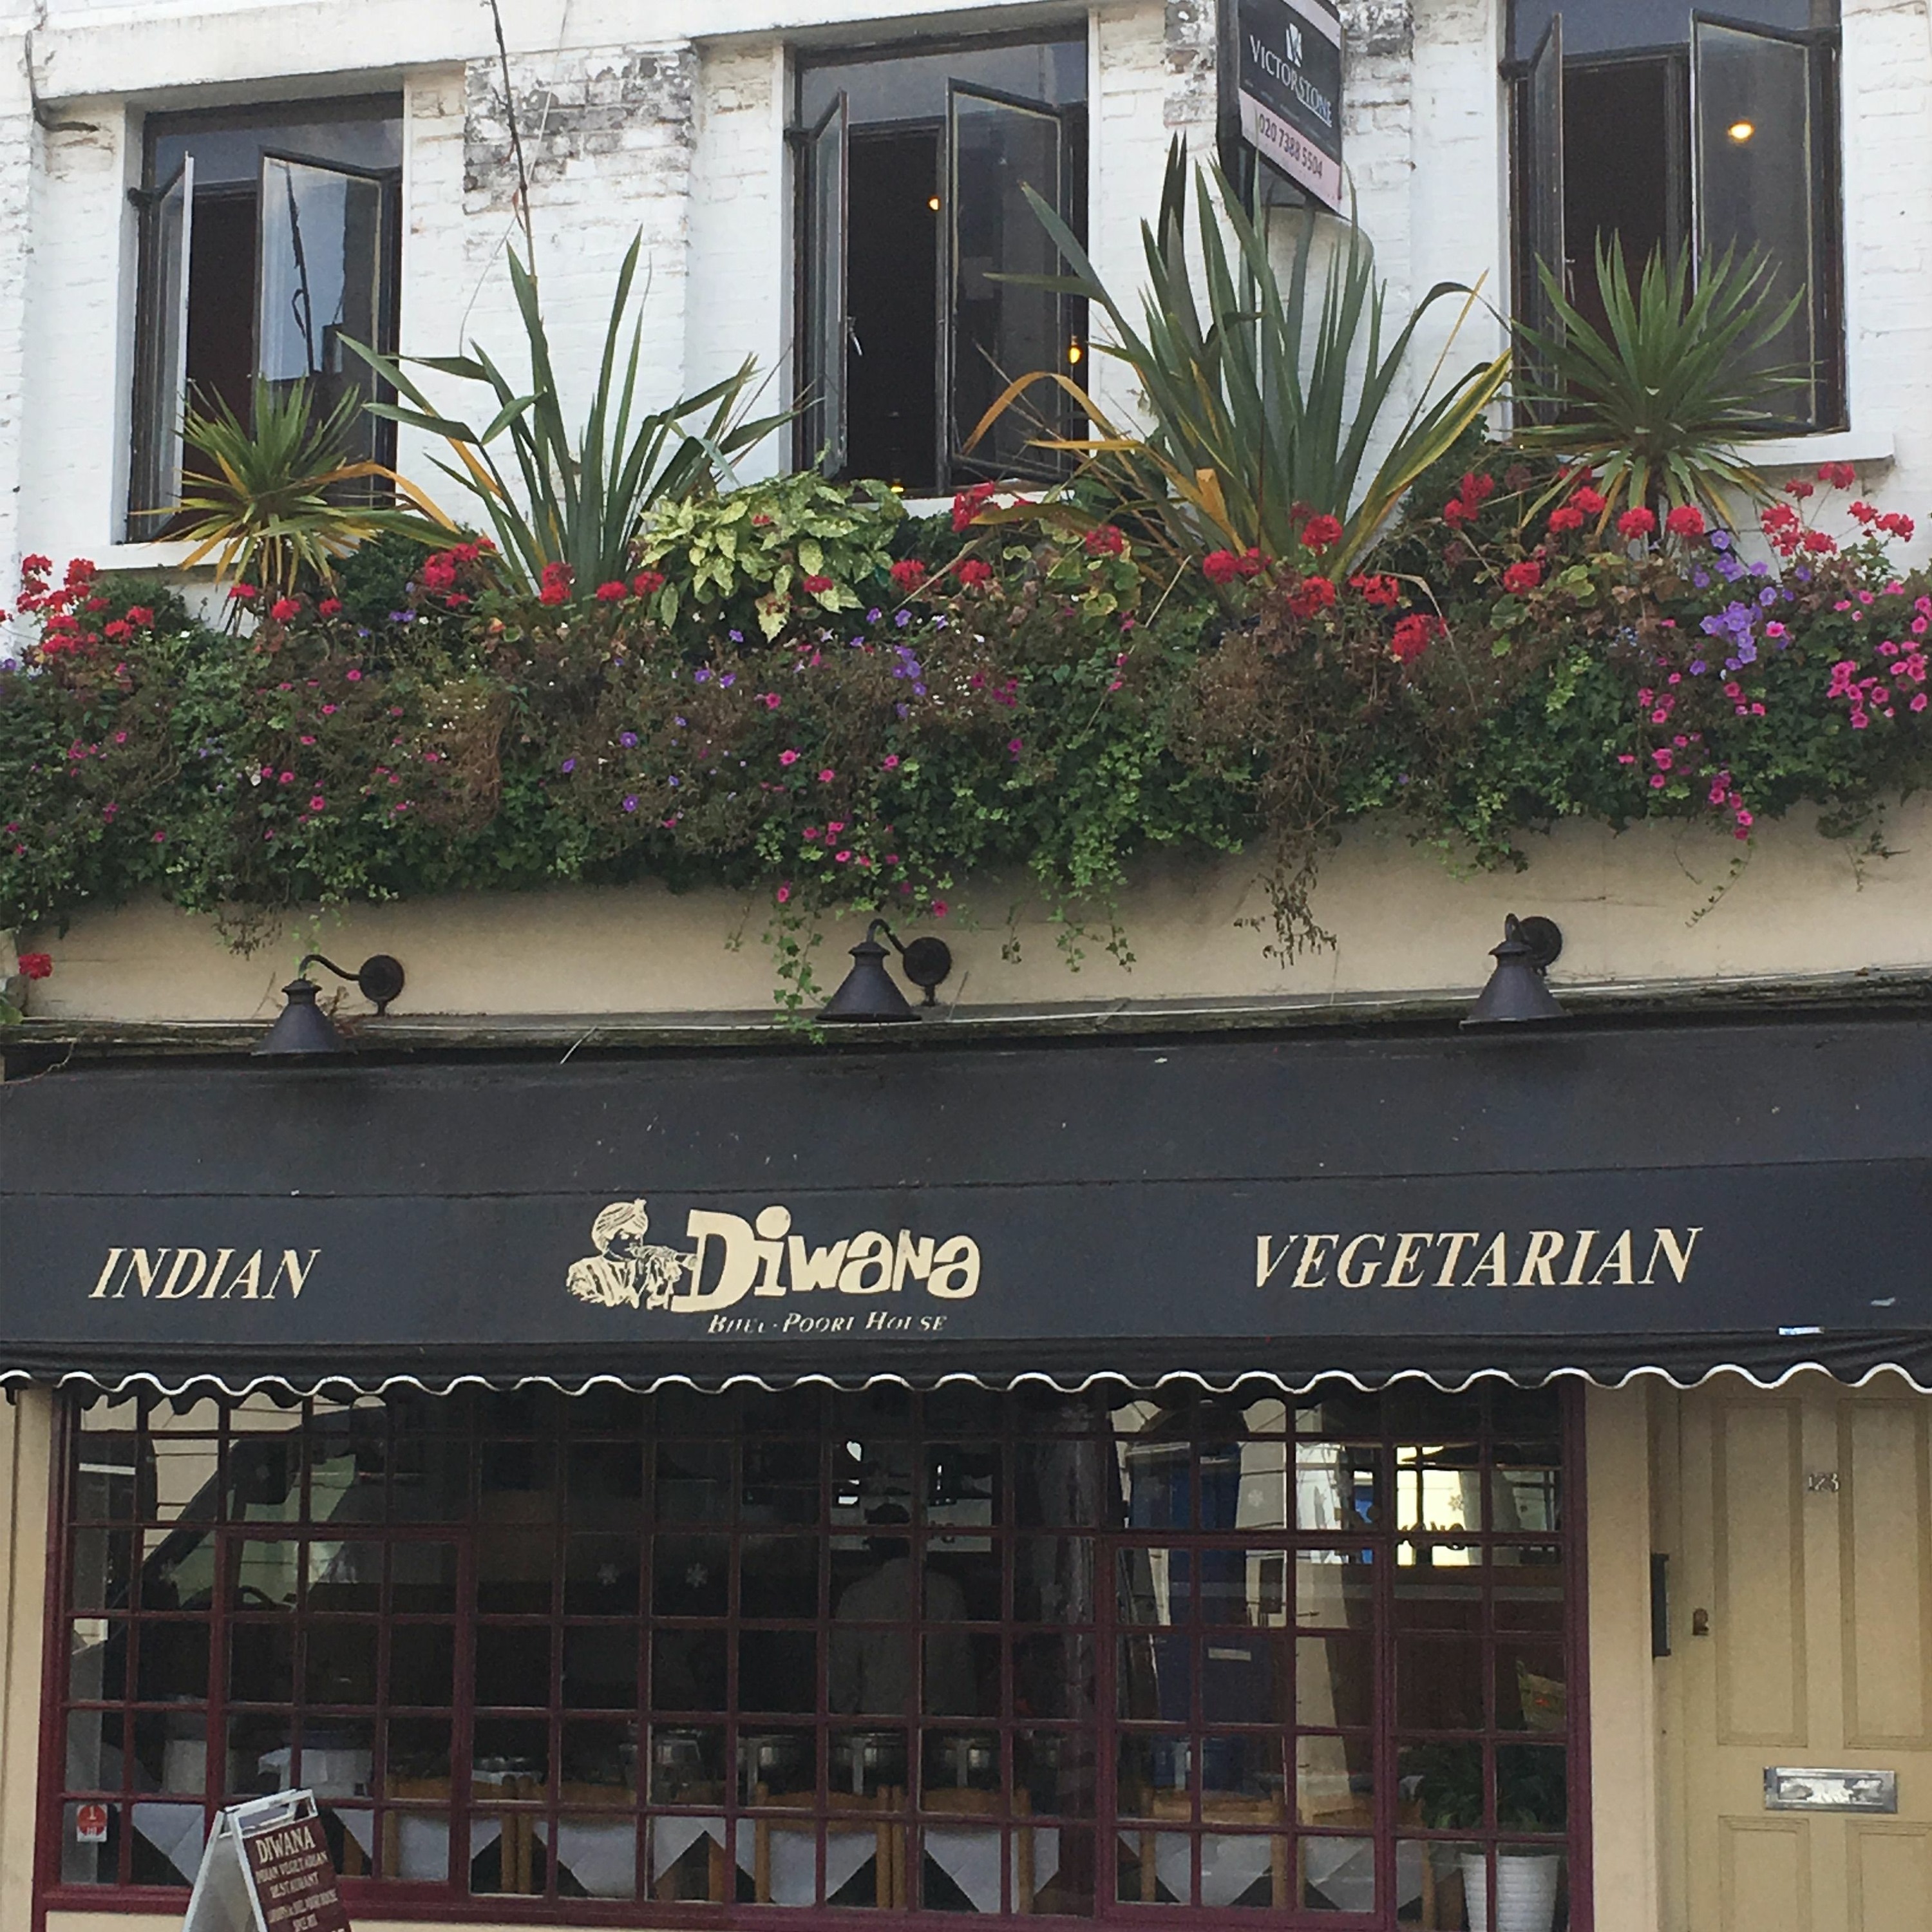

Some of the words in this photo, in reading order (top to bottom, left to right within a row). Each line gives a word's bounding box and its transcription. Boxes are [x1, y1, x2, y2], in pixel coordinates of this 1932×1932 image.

[1250, 35, 1332, 124] VICTORSTONE
[1259, 113, 1277, 142] 020
[88, 1247, 321, 1300] INDIAN
[1255, 1227, 1703, 1288] VEGETARIAN
[256, 1826, 316, 1864] DIWANA
